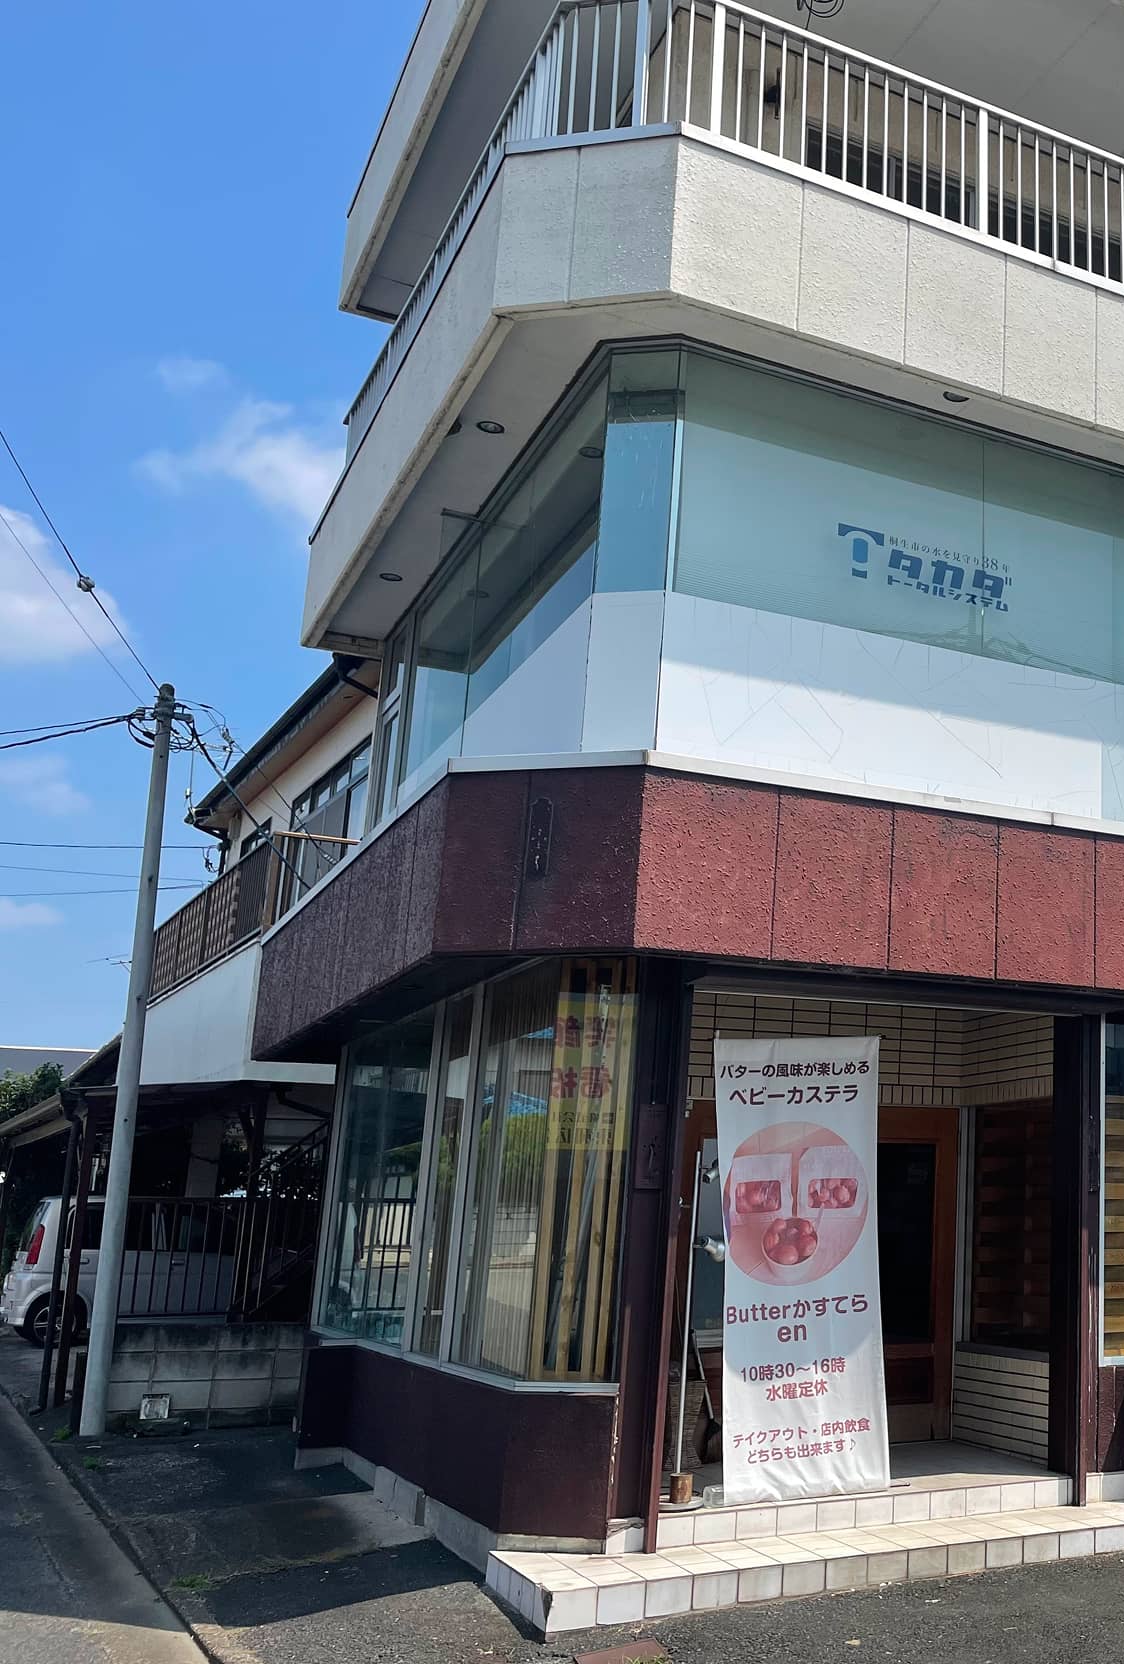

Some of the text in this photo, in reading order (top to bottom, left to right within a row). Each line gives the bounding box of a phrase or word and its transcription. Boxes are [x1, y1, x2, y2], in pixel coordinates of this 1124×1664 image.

[887, 574, 1009, 612] トータルシステム
[720, 1060, 870, 1079] バターの風味が楽しめる
[729, 1084, 859, 1106] ベビーカステラ
[726, 1294, 868, 1325] Butterかすてら
[777, 1323, 807, 1343] en
[766, 1379, 829, 1402] 水曜定休
[733, 1417, 871, 1449] テイクアウト・店内飲食
